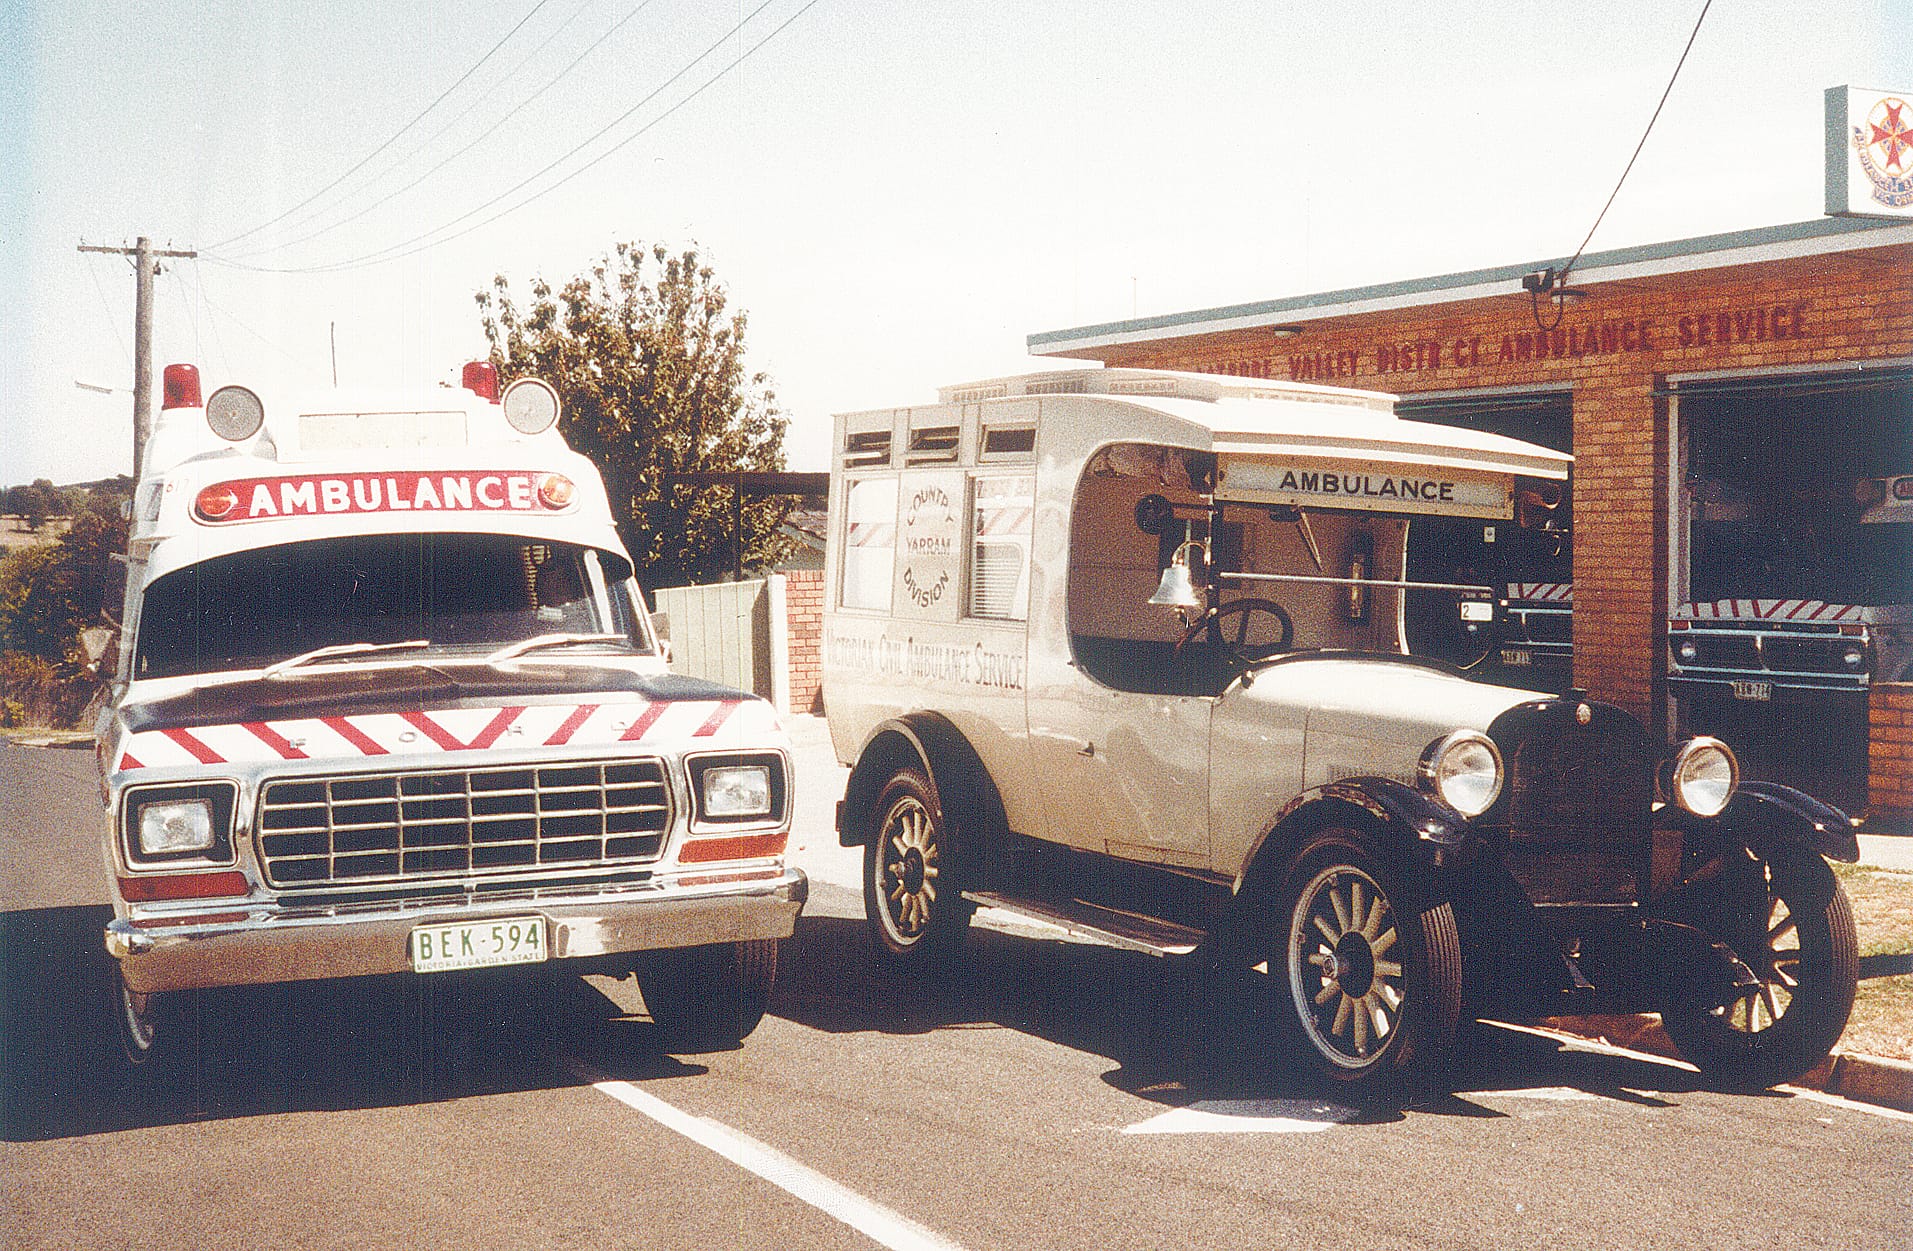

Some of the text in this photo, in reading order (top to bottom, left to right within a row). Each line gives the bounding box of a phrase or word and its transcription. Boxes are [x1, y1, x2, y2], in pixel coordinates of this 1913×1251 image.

[1289, 350, 1360, 381] VALLEY
[1378, 336, 1481, 374] DISTRCT
[1500, 321, 1654, 363] AMBULANCE
[1679, 306, 1807, 347] SERVICE
[249, 476, 532, 516] AMBULANCE
[1279, 471, 1455, 501] AMBULANCE
[903, 567, 949, 607] DIVISION
